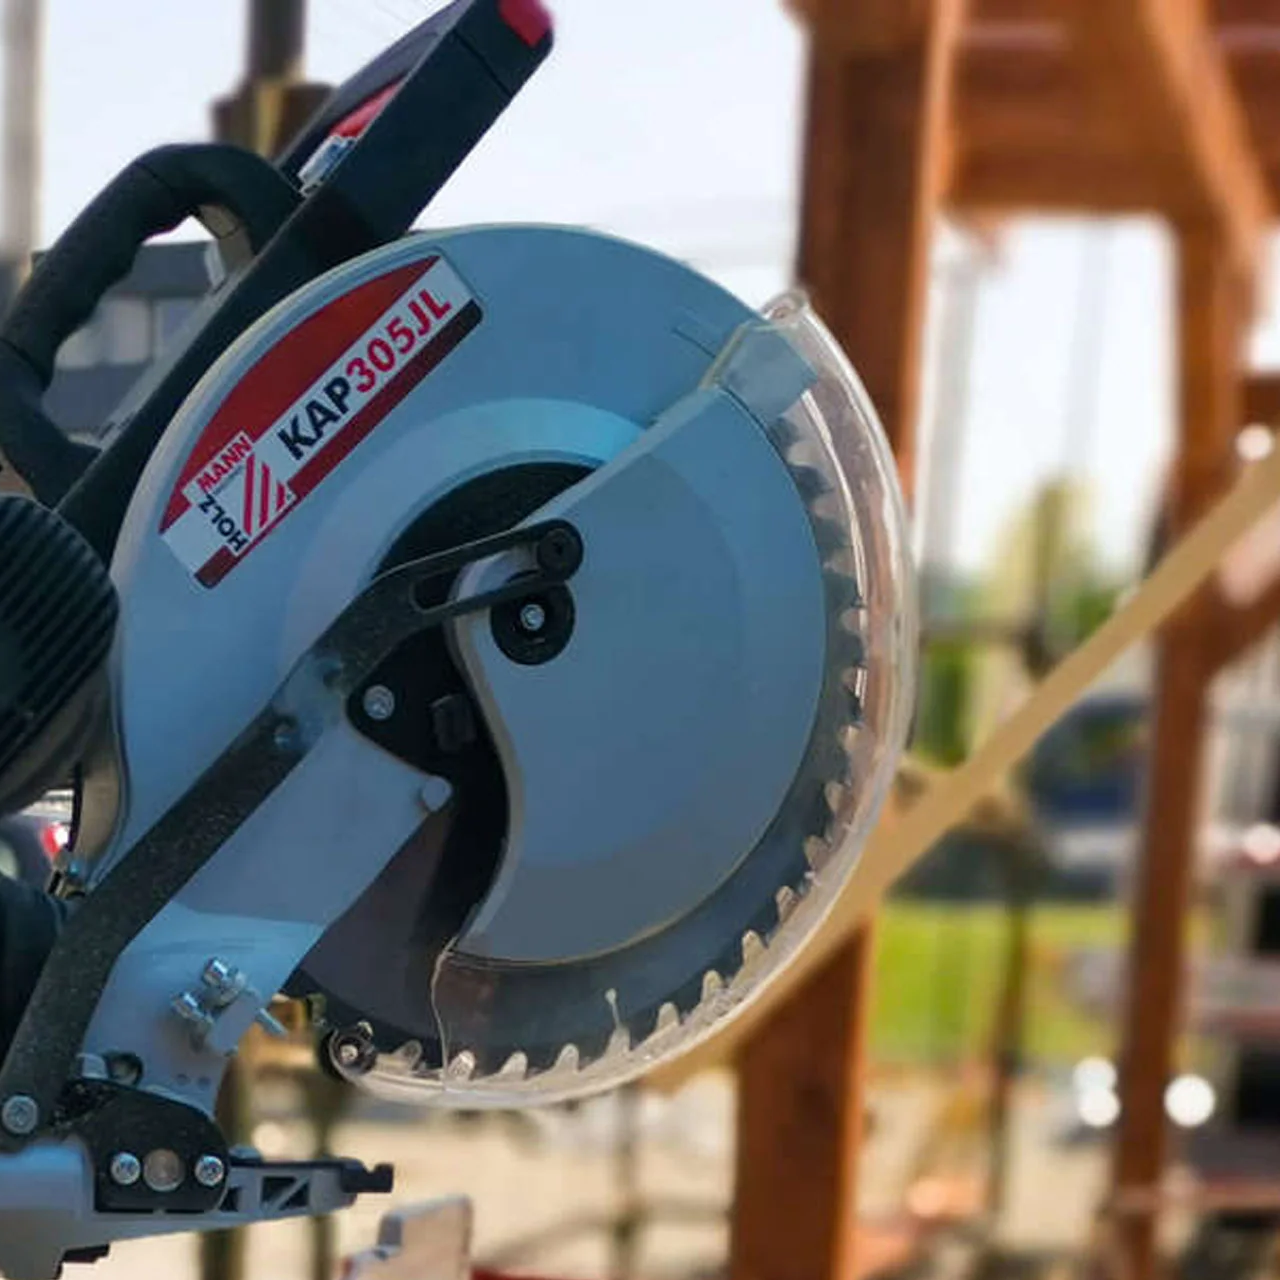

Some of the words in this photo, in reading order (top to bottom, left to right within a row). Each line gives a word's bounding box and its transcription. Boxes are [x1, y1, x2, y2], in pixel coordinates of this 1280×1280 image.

[277, 289, 452, 461] KAP305JL
[196, 435, 253, 495] MANN
[198, 494, 250, 553] HOLZ
